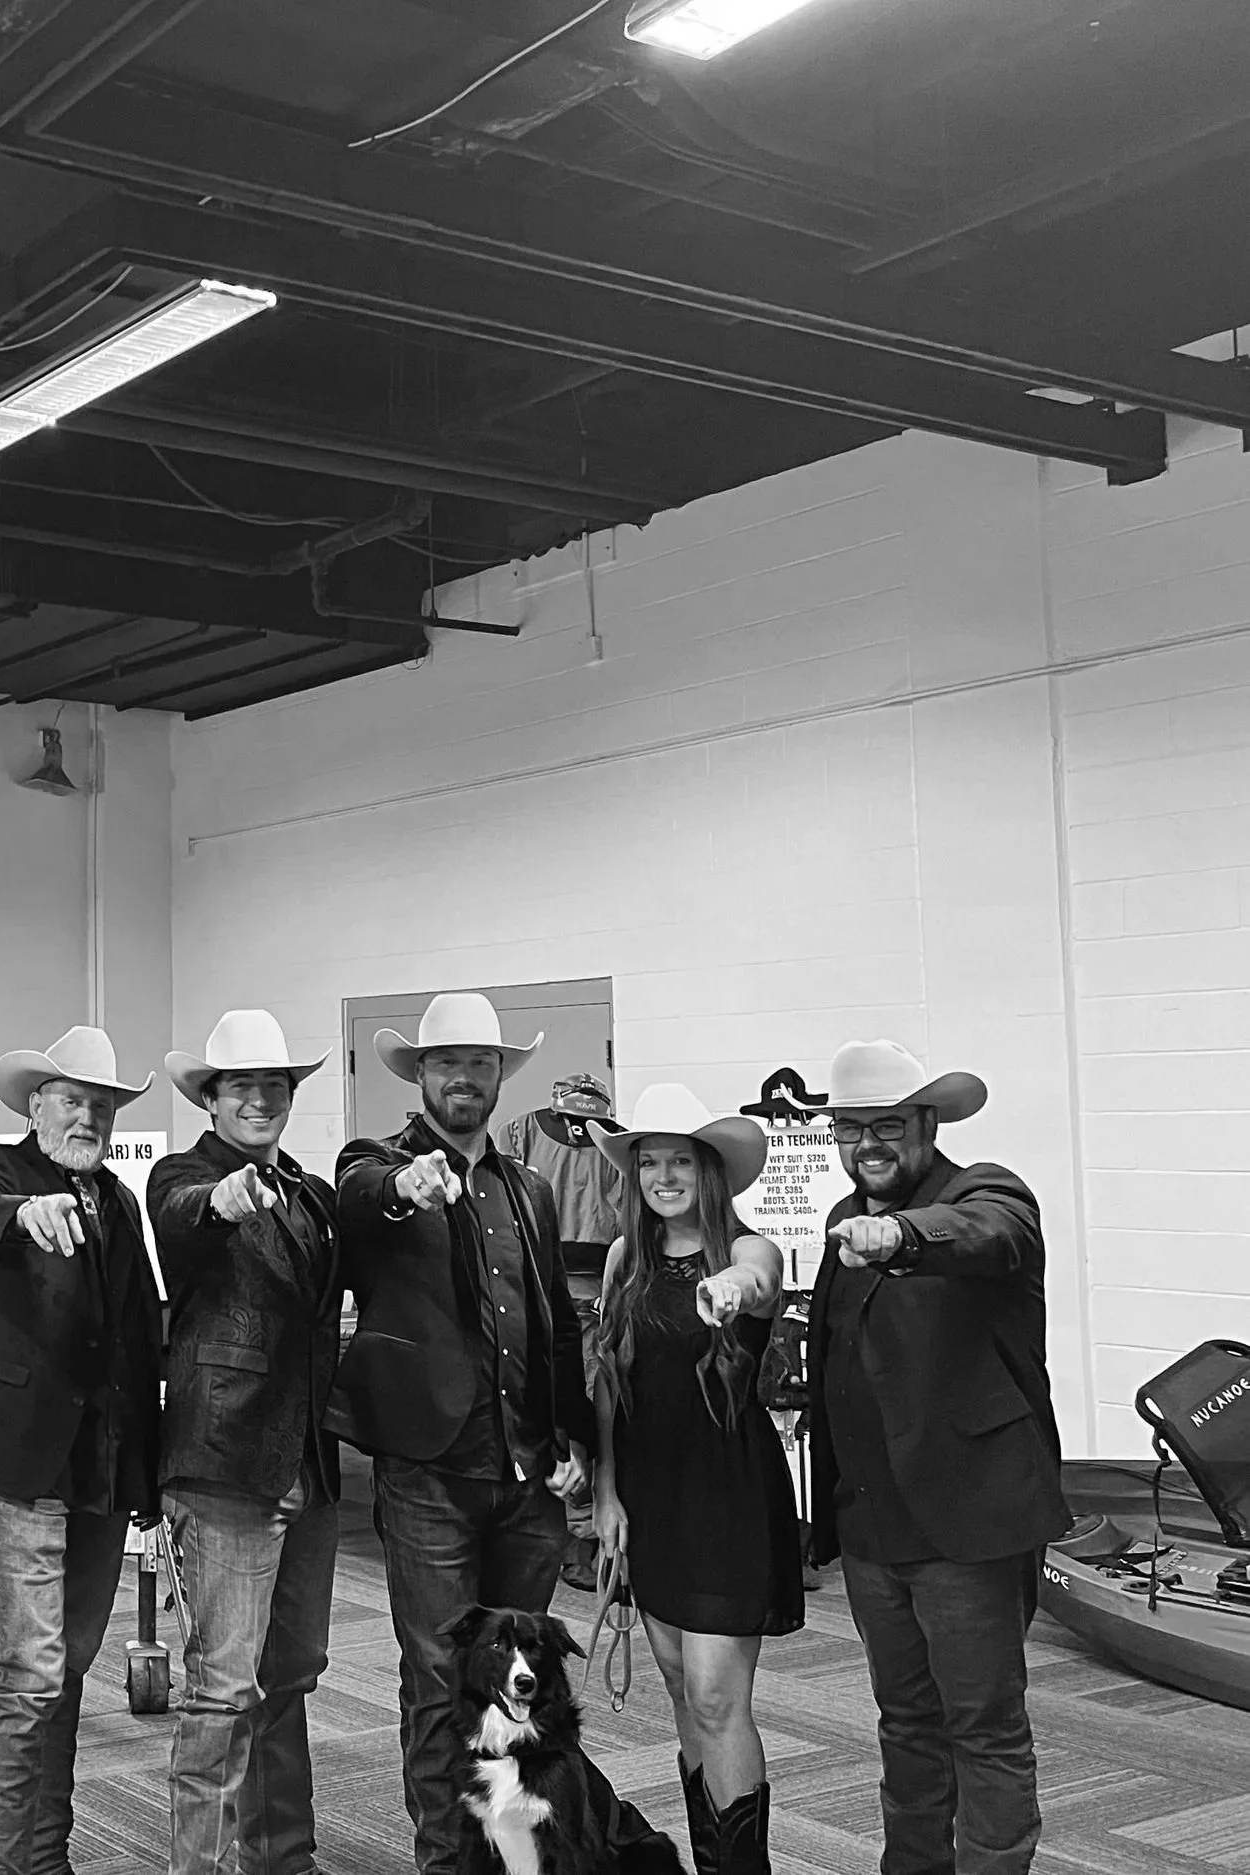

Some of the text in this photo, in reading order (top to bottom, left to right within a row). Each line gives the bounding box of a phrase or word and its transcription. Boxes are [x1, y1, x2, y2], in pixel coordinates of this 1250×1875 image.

[135, 1144, 152, 1160] K9
[770, 1154, 826, 1163] WET SUIT: $320
[767, 1166, 781, 1174] DRY
[784, 1165, 802, 1173] SUIT:
[759, 1175, 810, 1184] HELMET: $150
[767, 1186, 782, 1194] PFD:
[763, 1196, 809, 1204] BOOTS: $120
[754, 1206, 818, 1215] TRAINING: $400+
[1190, 1378, 1250, 1428] NUCANOE
